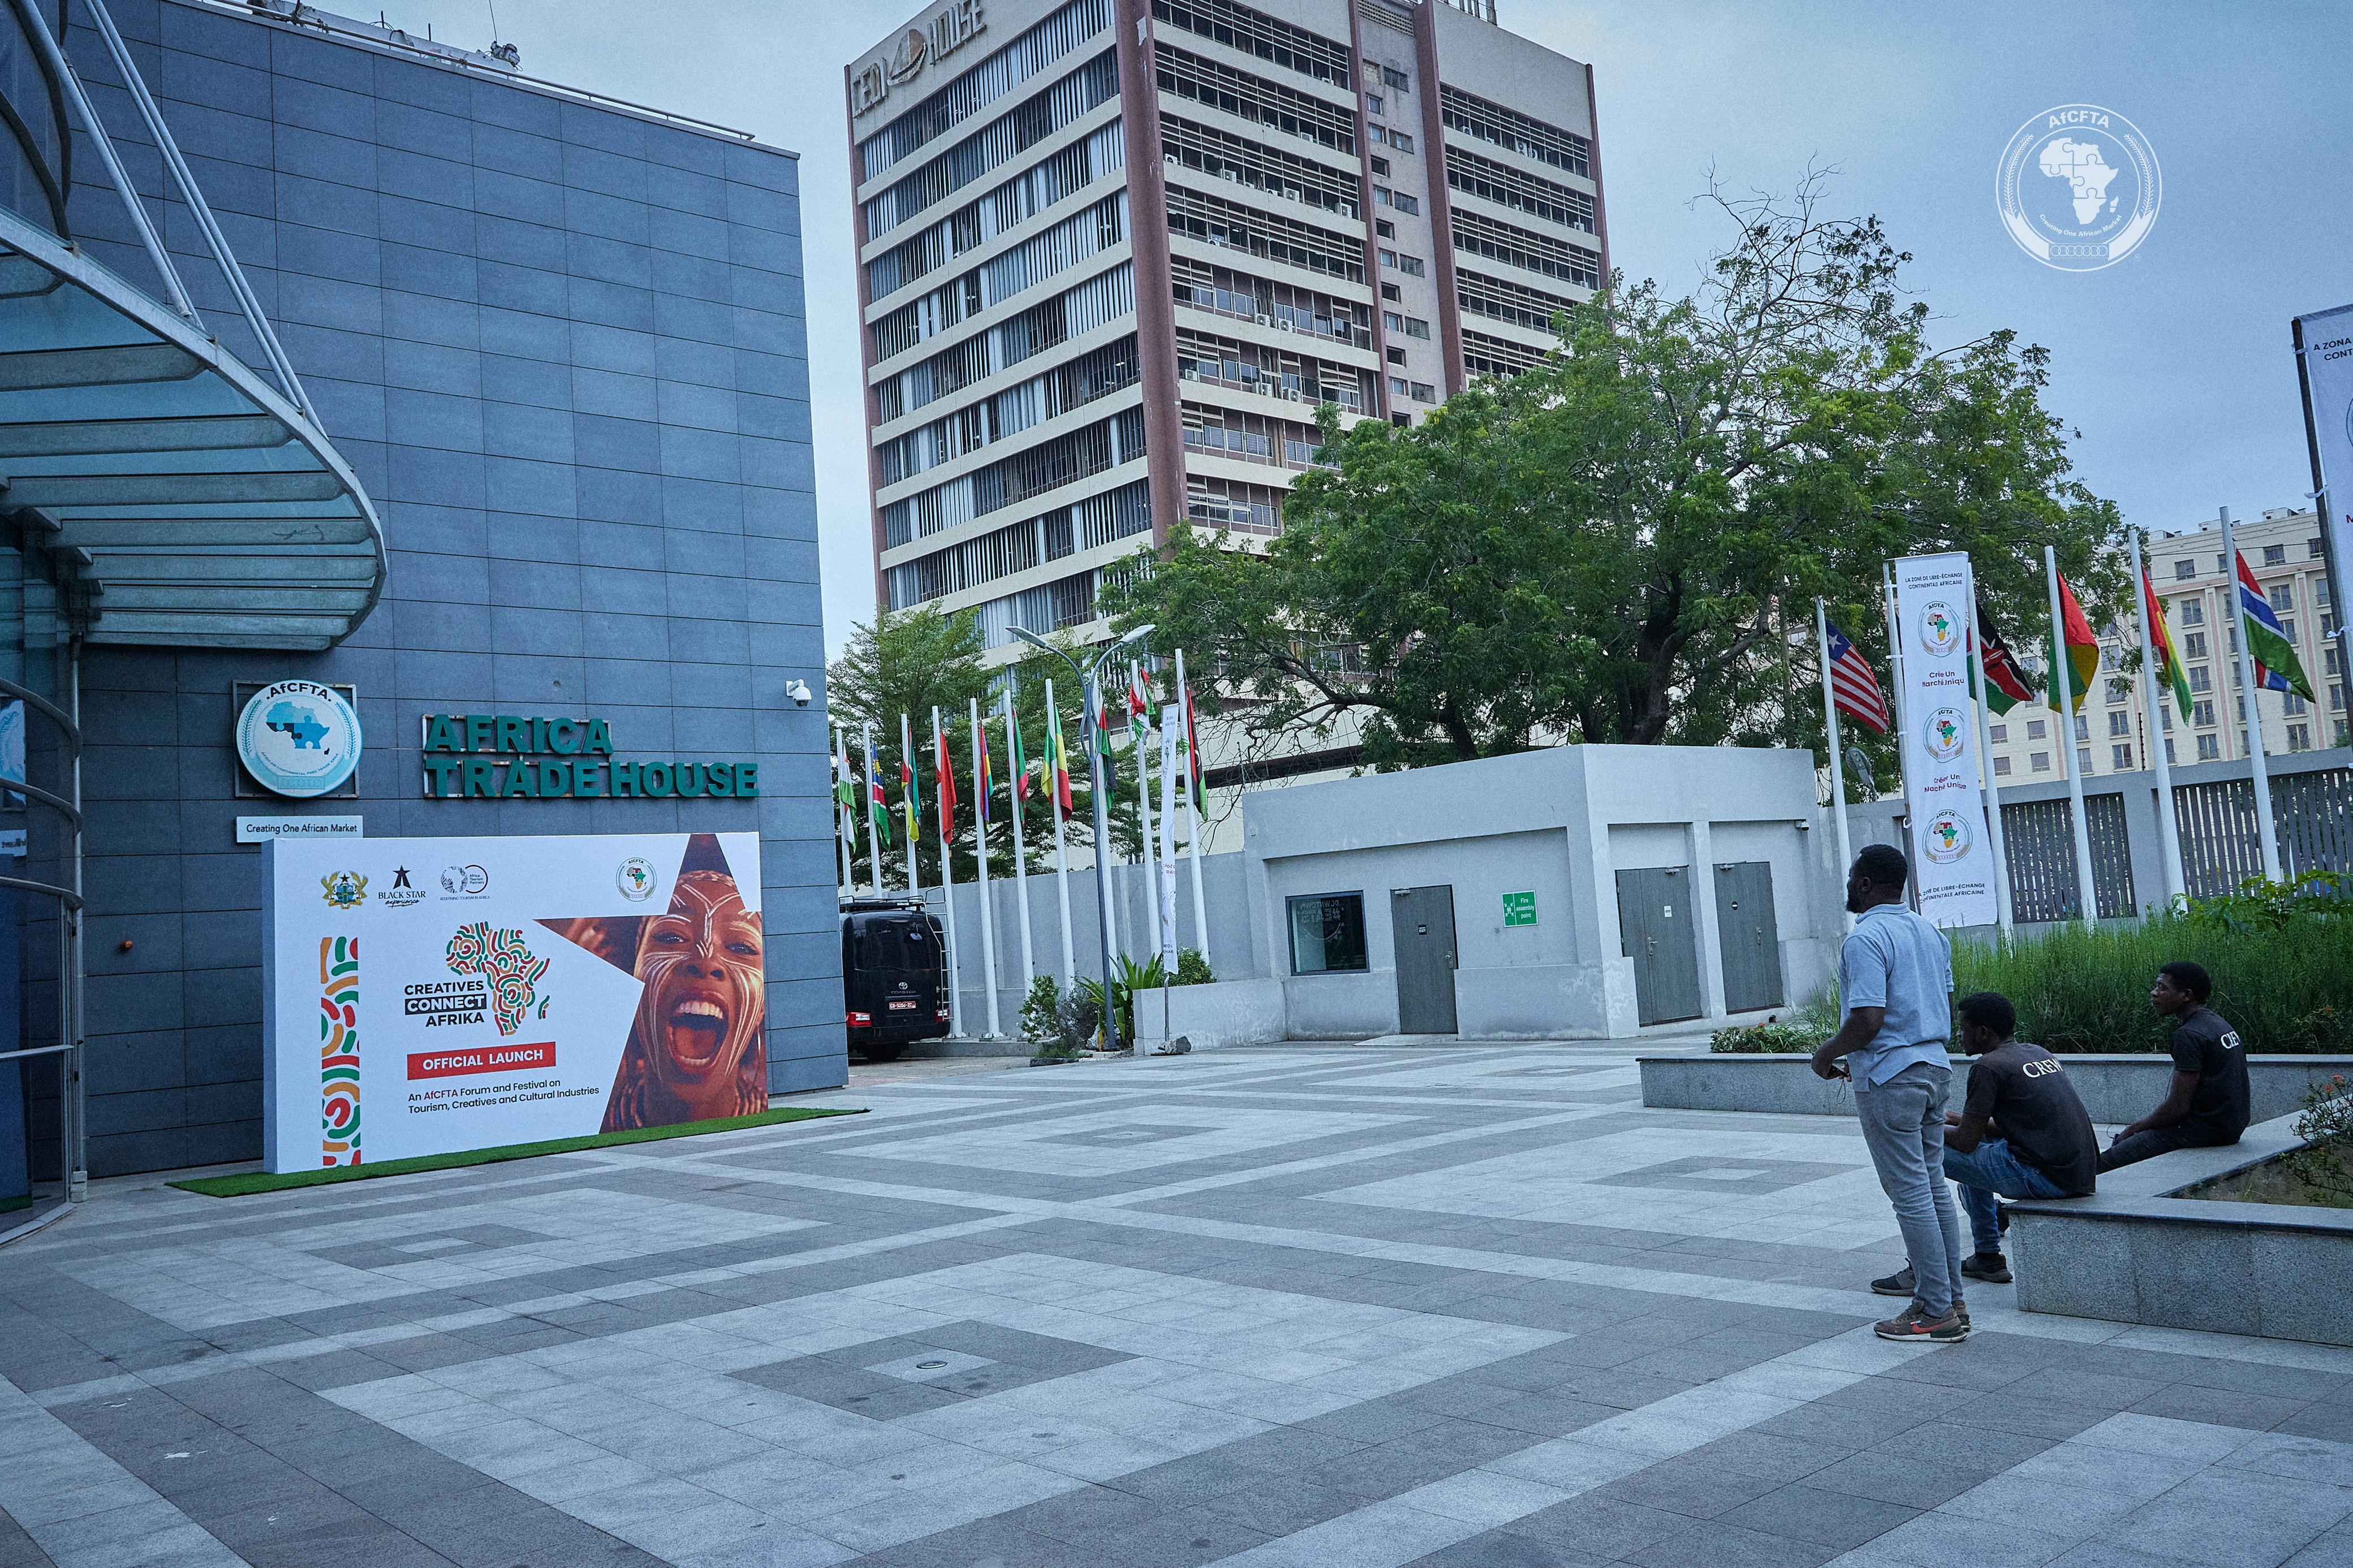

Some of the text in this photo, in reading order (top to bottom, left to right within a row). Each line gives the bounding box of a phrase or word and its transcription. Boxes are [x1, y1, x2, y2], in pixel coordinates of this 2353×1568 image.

[851, 0, 986, 118] CEDI HOUSE
[2322, 338, 2351, 349] ZONA
[424, 714, 614, 755] AFRICA
[424, 758, 760, 797] TRADE HOUSE
[246, 824, 281, 835] Creating
[301, 823, 329, 832] African
[330, 823, 357, 832] Market
[385, 899, 420, 908] experience
[404, 980, 484, 995] CREATIVES
[407, 995, 485, 1012] CONNECT
[425, 1012, 485, 1027] AFRIKA
[423, 1049, 543, 1070] OFFICIAL LAUNCH
[2023, 1058, 2063, 1078] CREW
[424, 1089, 458, 1100] AfCFTA
[460, 1087, 490, 1096] Forum
[493, 1085, 511, 1093] and
[513, 1079, 548, 1091] Festival
[408, 1087, 600, 1113] Tourism, Creatives and Cultural Industries
